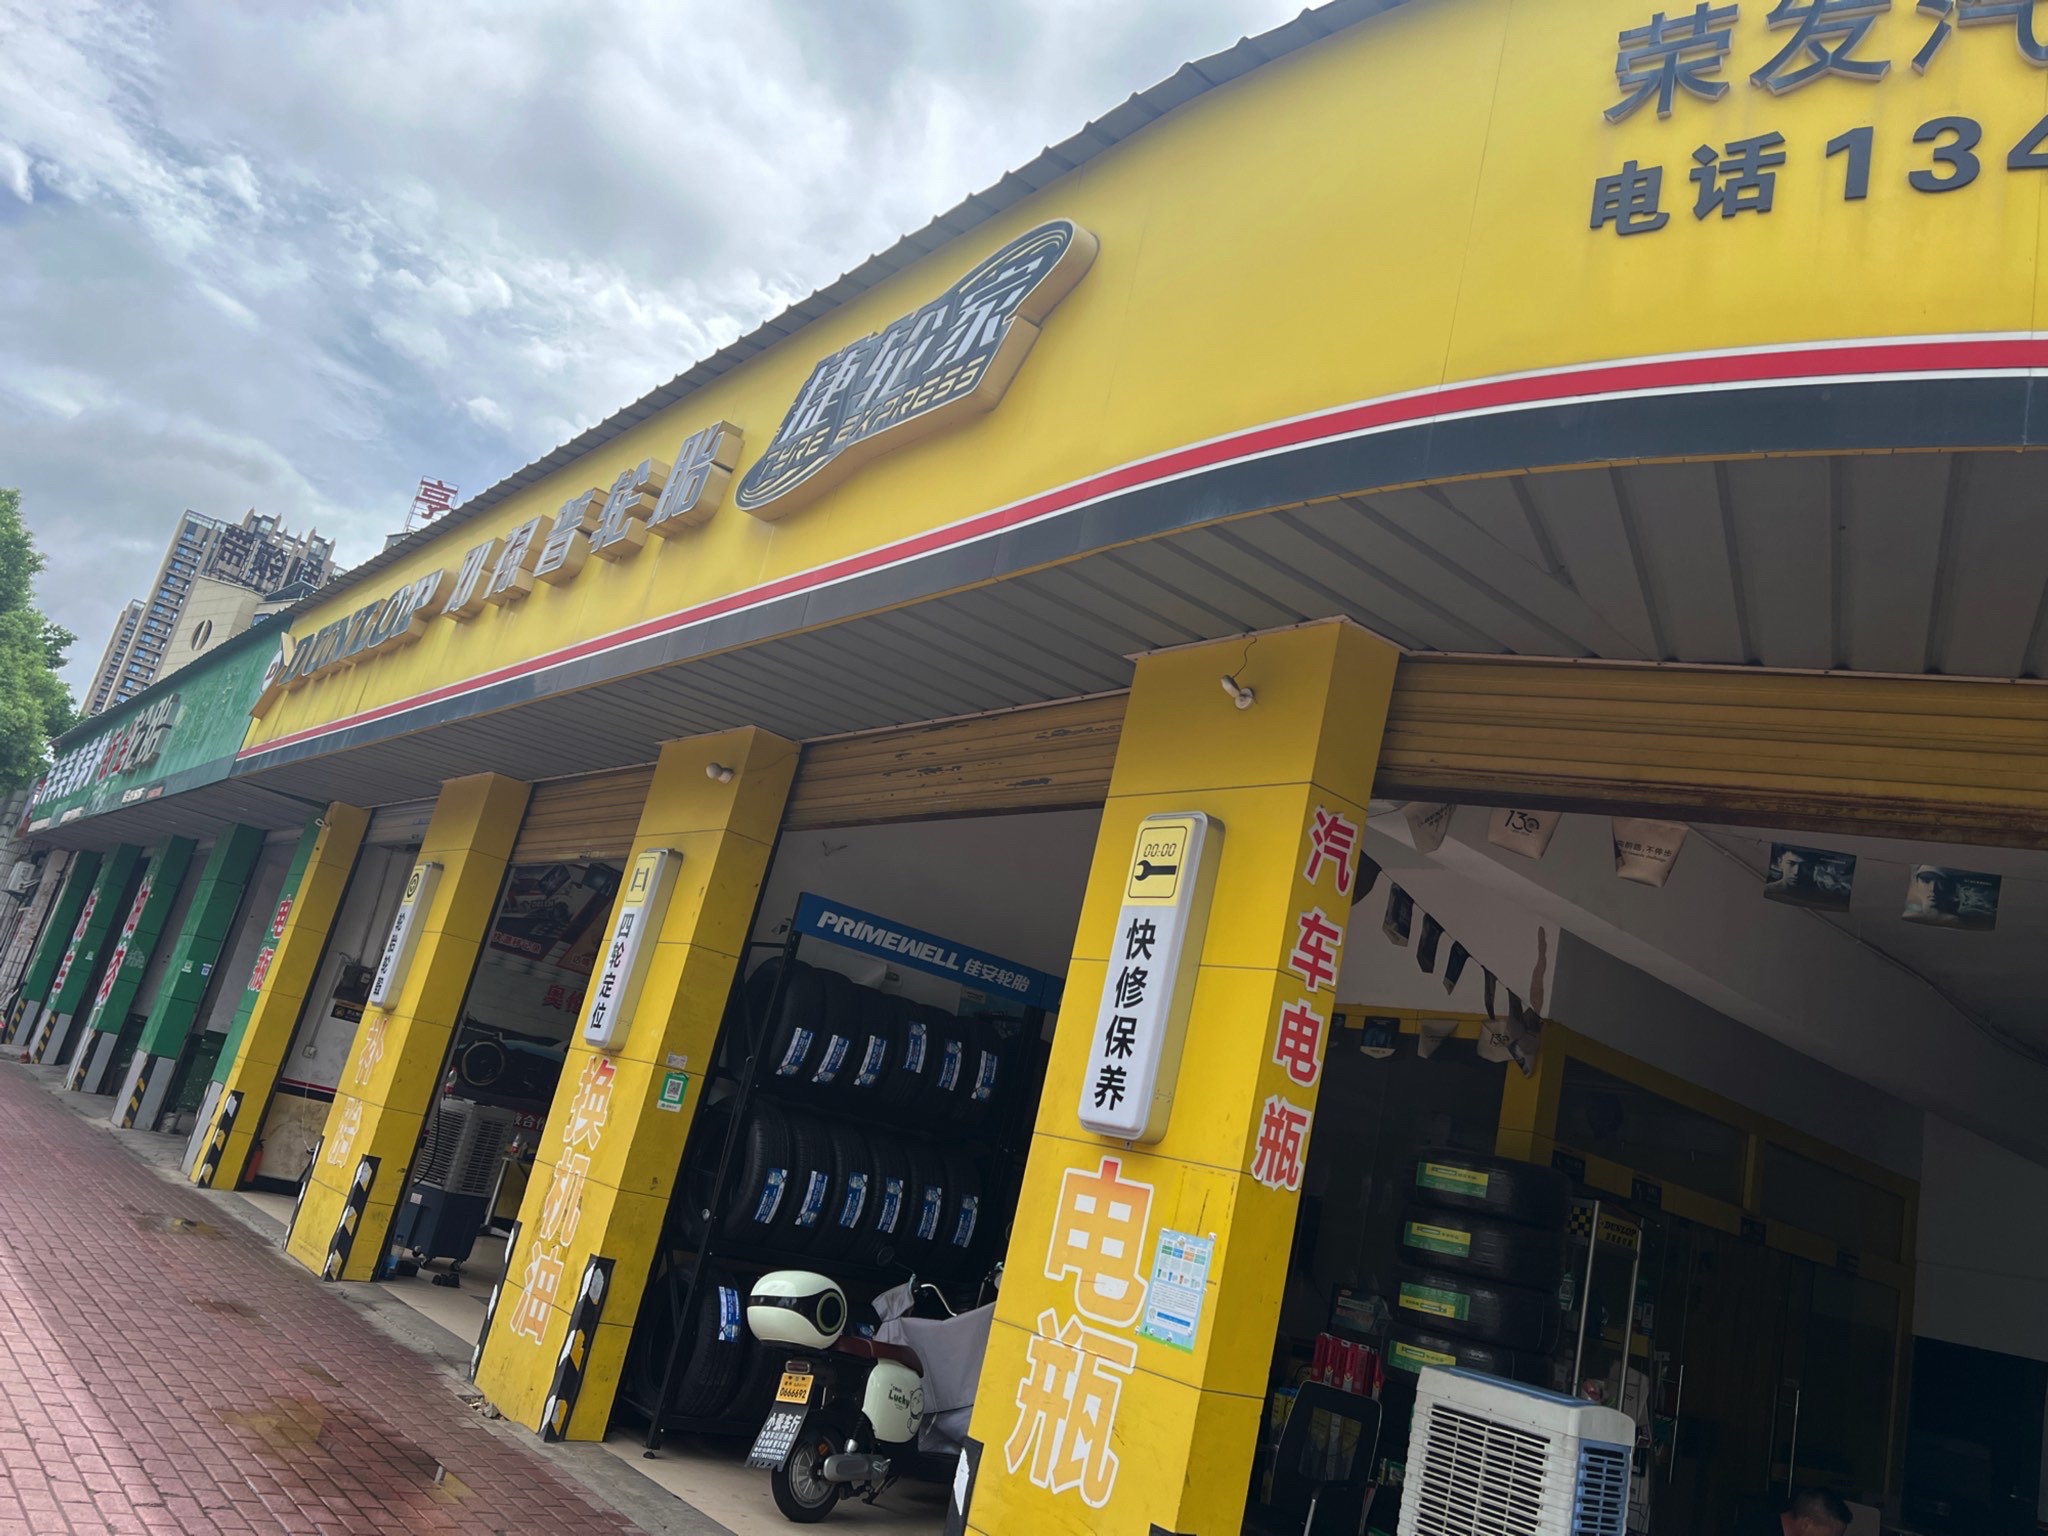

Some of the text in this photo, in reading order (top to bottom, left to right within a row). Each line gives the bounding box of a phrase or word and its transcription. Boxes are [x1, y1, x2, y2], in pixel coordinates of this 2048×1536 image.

[760, 355, 986, 477] TYRE EXPRESS
[778, 256, 1044, 444] 捷轮家
[440, 420, 732, 618] 邓禄普轮胎
[277, 567, 444, 687] DUNLOP
[248, 893, 292, 992] 电瓶
[591, 914, 635, 1029] 四轮定位
[816, 910, 960, 970] PRIMEWELL
[963, 957, 1031, 993] 佳安轮胎
[1252, 805, 1356, 1190] 汽车电瓶
[1094, 918, 1156, 1111] 快修保养
[327, 1017, 389, 1168] 补胎
[510, 1055, 617, 1346] 换机油
[888, 1388, 911, 1409] Lucky
[1004, 1155, 1154, 1508] 电瓶
